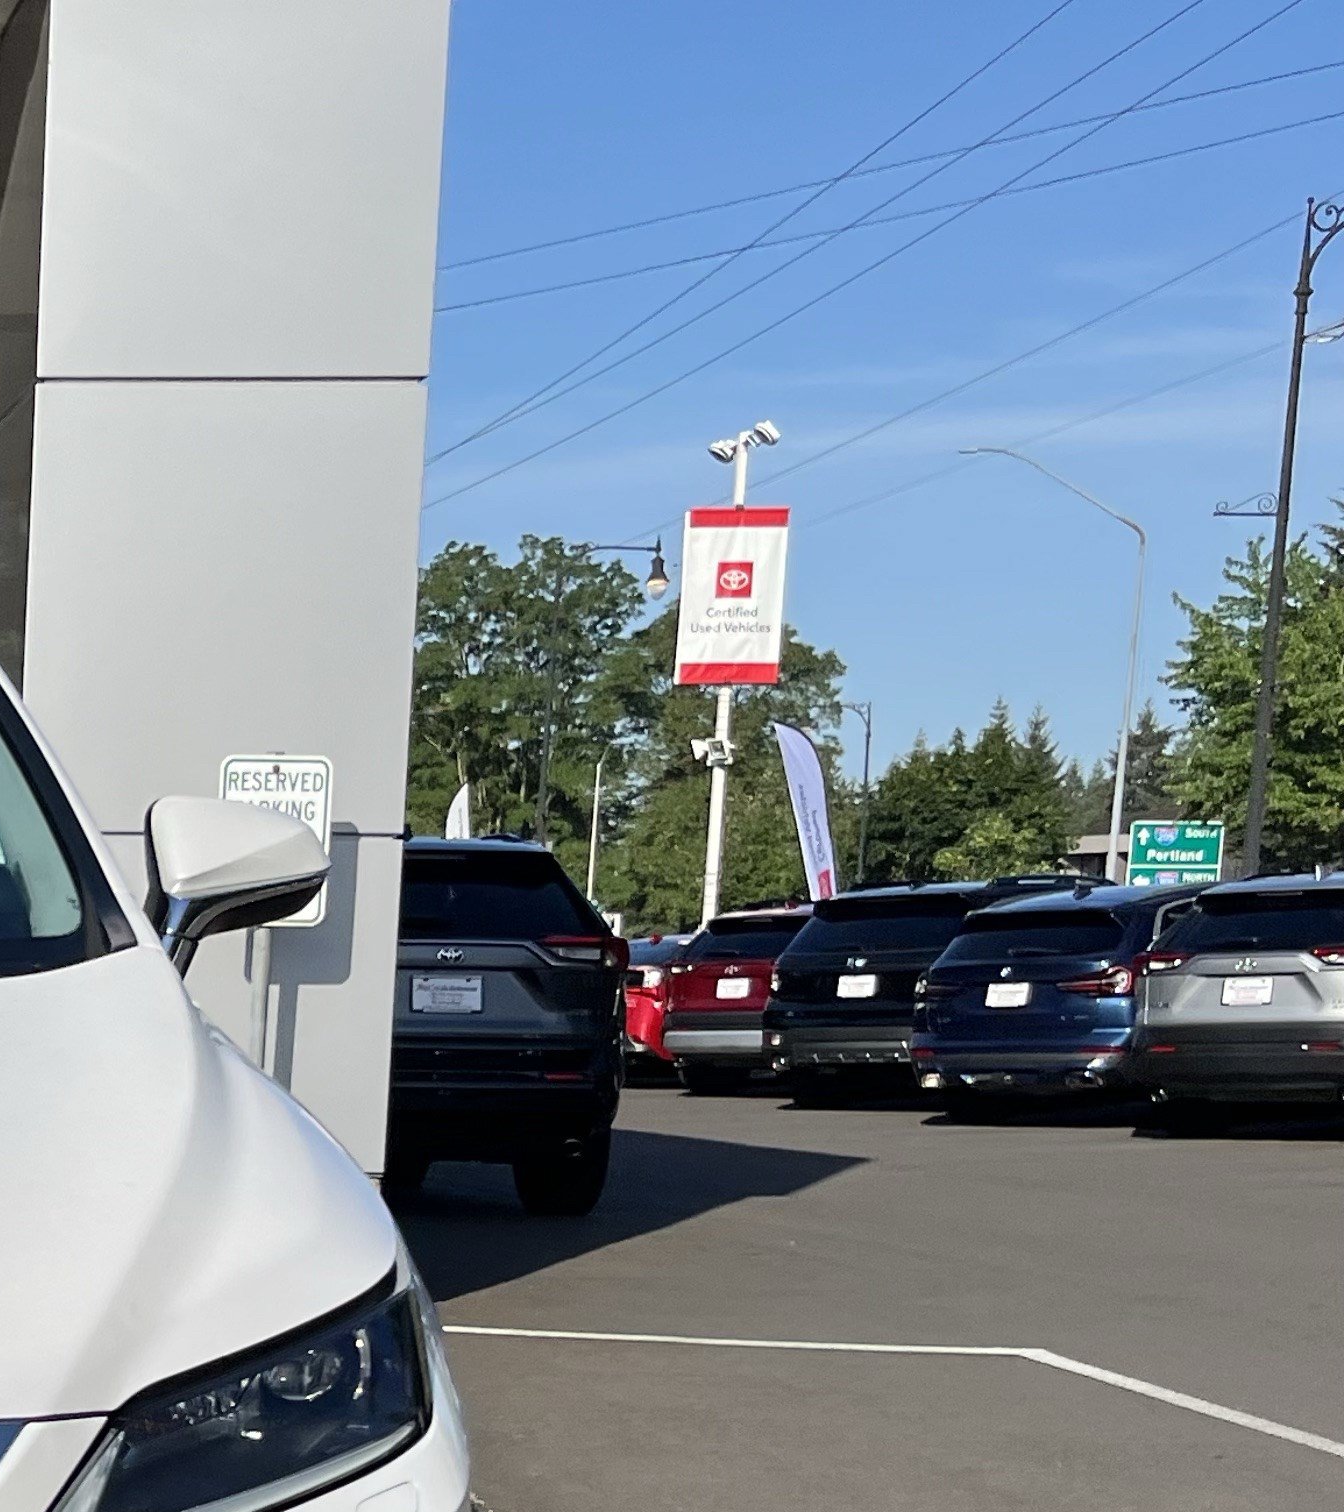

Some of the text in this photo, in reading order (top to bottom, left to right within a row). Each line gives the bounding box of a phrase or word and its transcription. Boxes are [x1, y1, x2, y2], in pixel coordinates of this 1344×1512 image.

[706, 605, 758, 618] Certified
[690, 622, 771, 633] Used Vehicles
[228, 771, 324, 791] RESERVED
[1146, 849, 1204, 862] Portland
